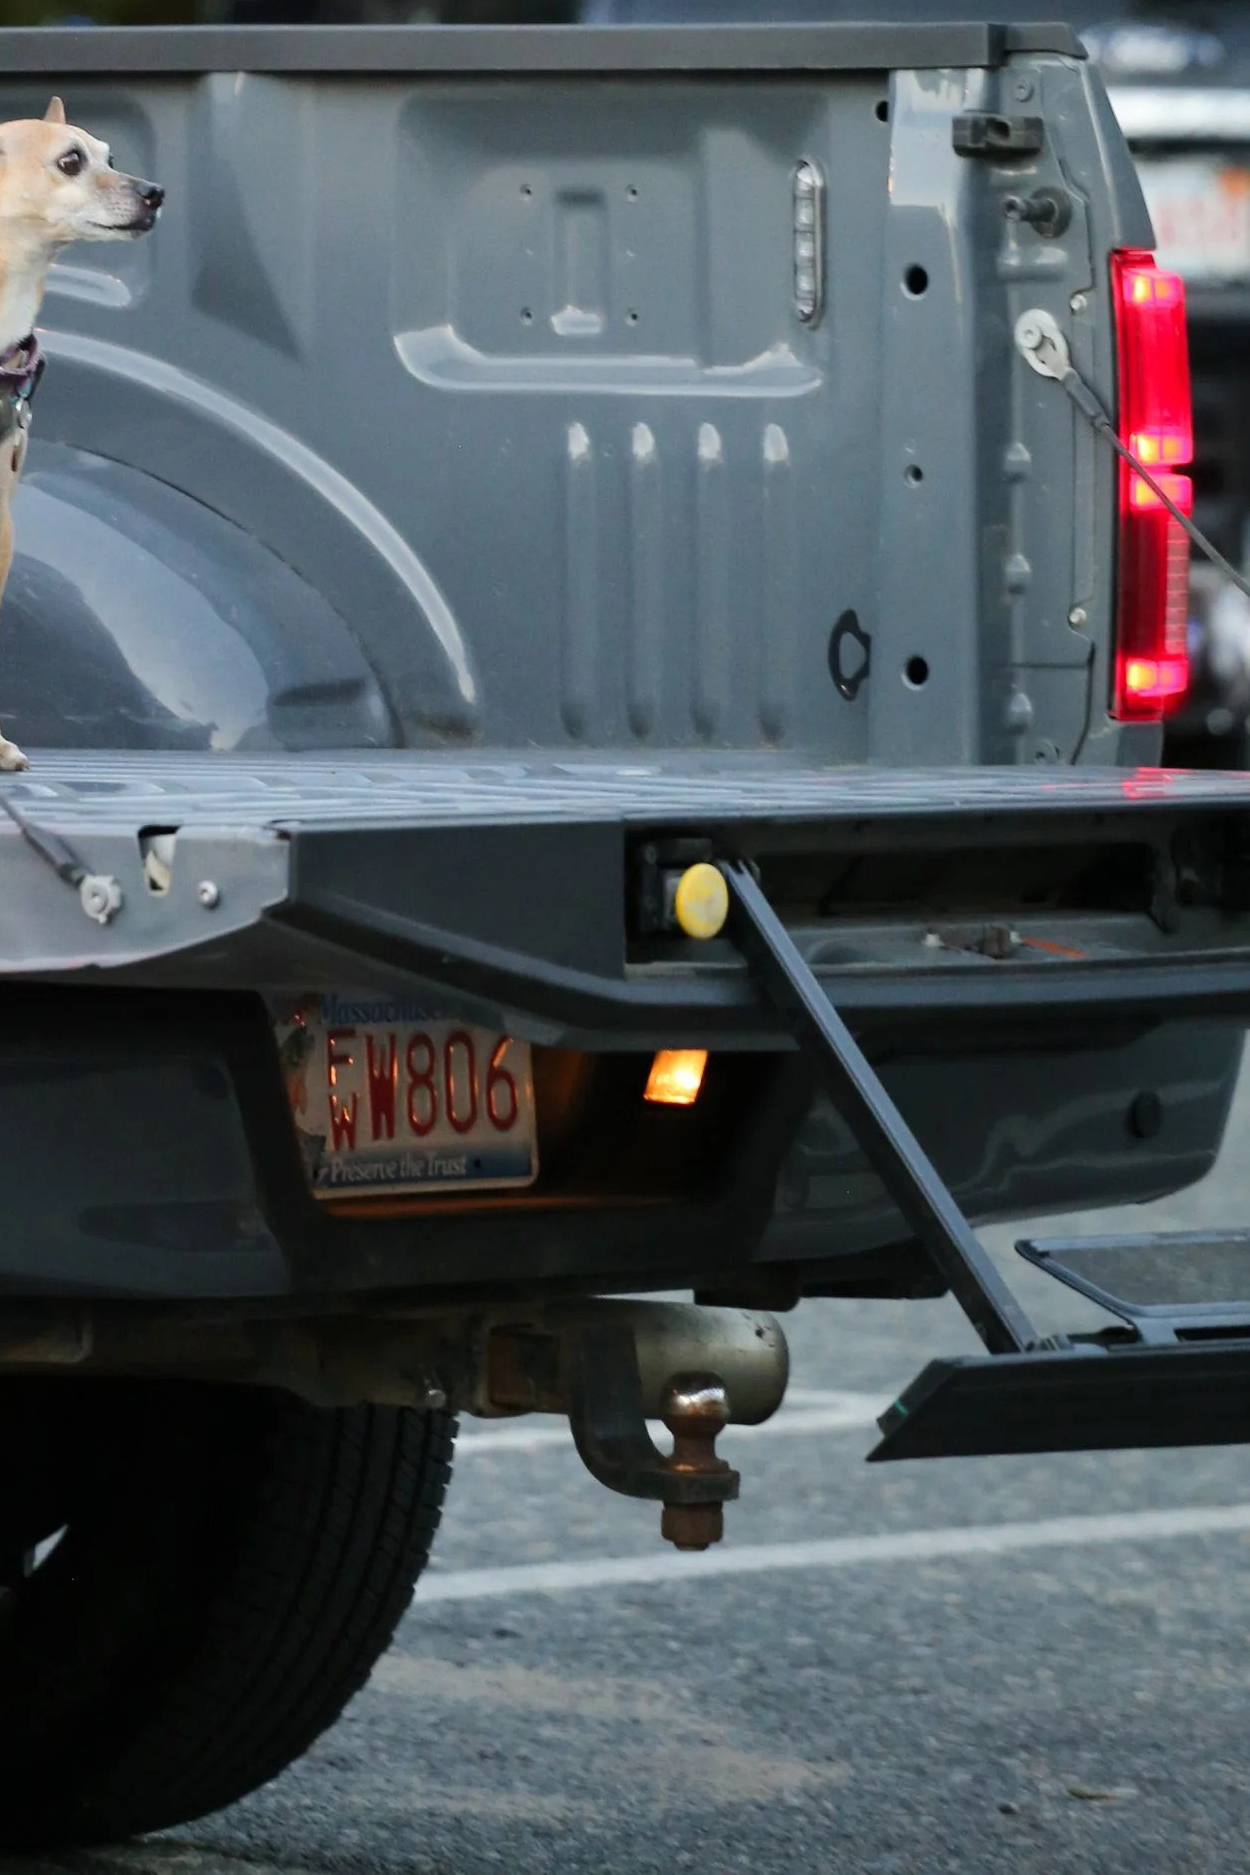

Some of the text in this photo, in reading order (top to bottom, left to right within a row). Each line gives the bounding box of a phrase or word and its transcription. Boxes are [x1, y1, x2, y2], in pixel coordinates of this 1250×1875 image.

[321, 994, 442, 1024] Massachus
[330, 1150, 466, 1183] Preserve the Trust
